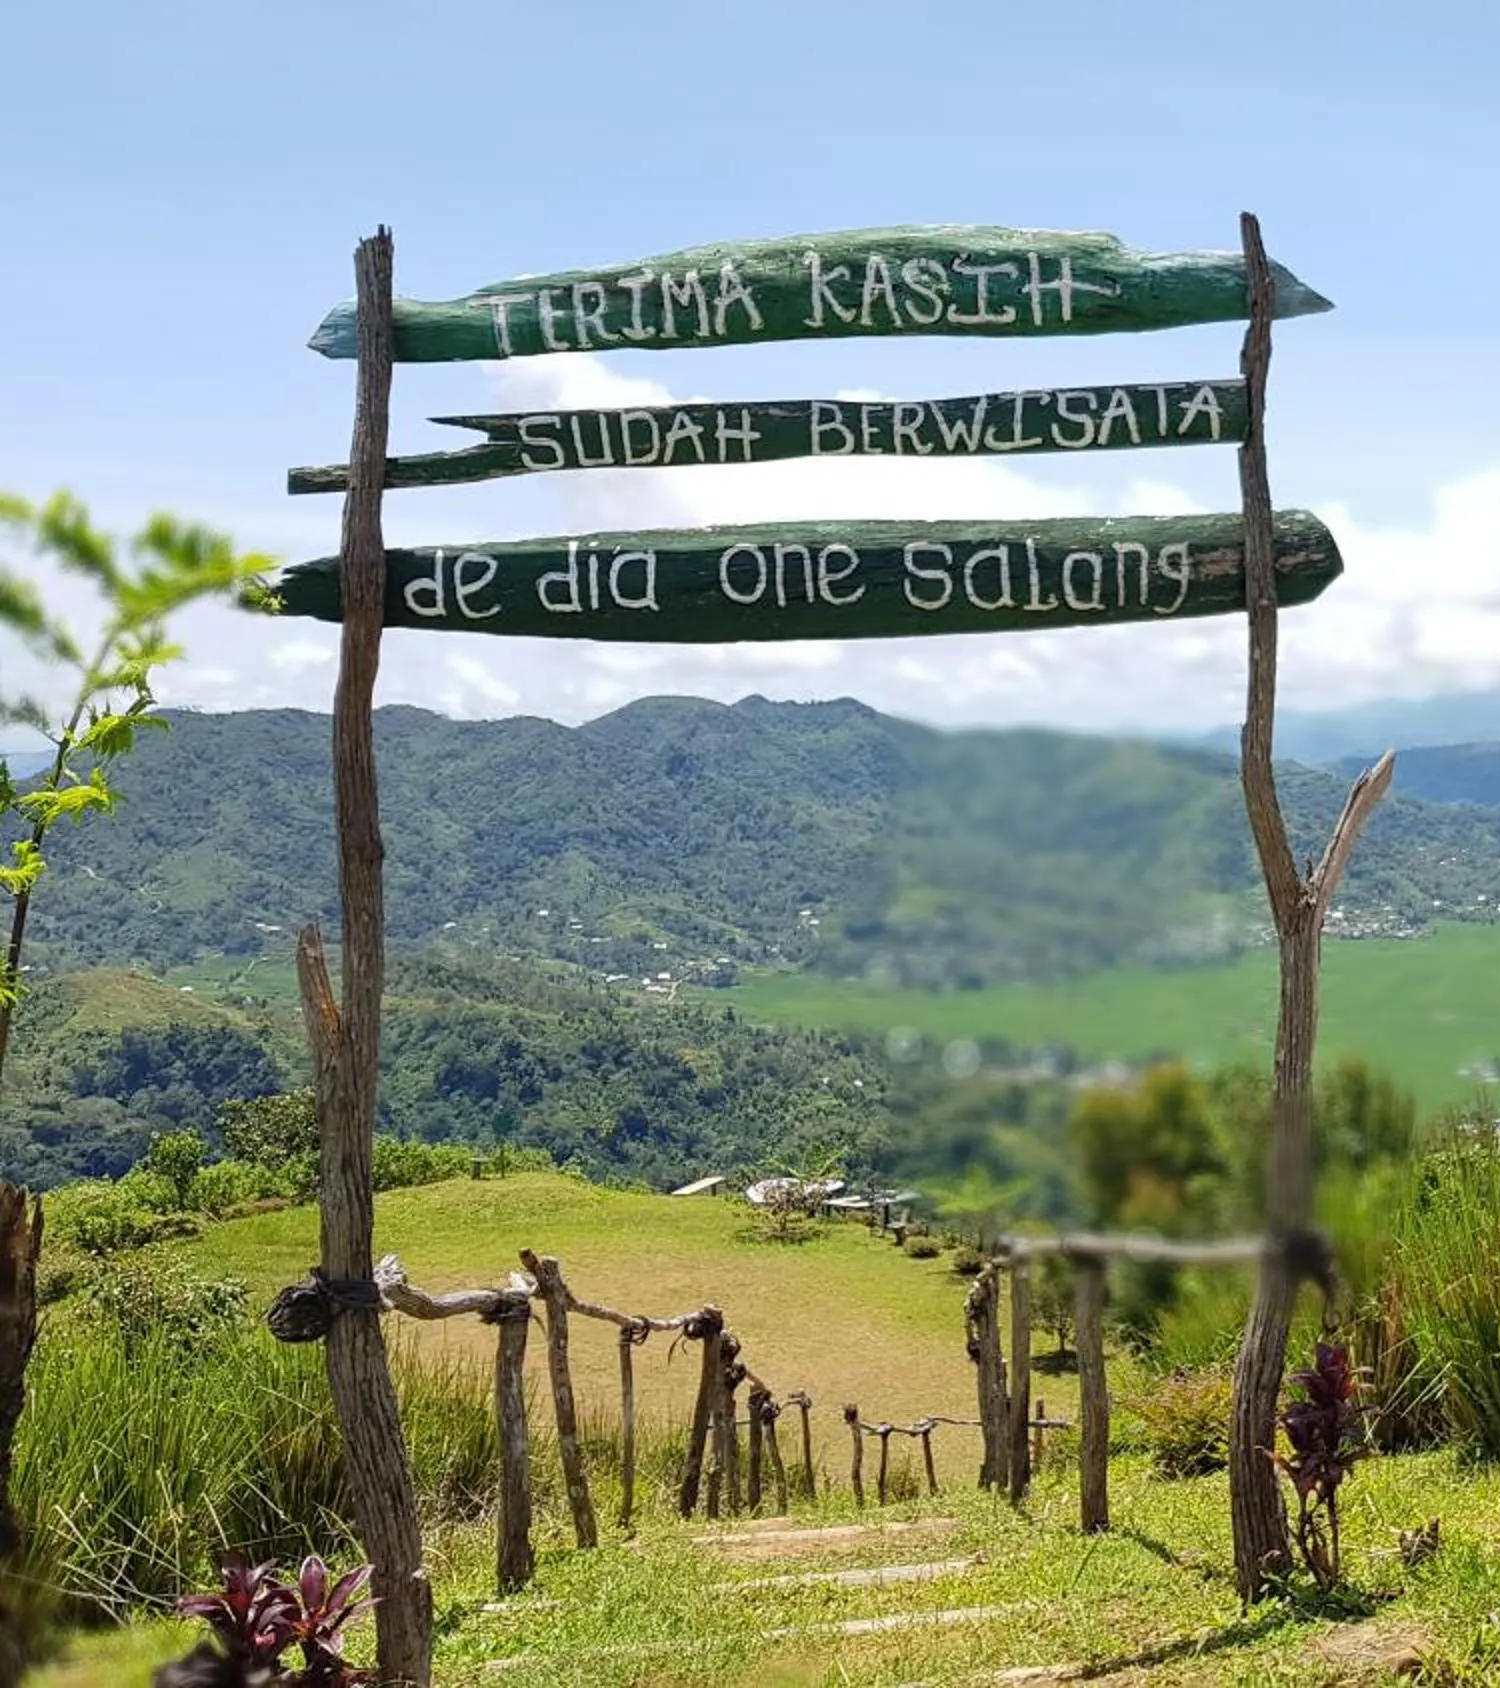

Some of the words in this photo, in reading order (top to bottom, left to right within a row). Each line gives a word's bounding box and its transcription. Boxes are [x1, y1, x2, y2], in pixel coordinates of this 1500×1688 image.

[465, 252, 765, 357] TERIMA
[803, 250, 1121, 328] KASIH
[517, 407, 762, 471] SUDAH
[810, 384, 1224, 456] BERWISATA
[402, 548, 501, 619] de
[537, 540, 661, 613] dia
[718, 542, 867, 607] one
